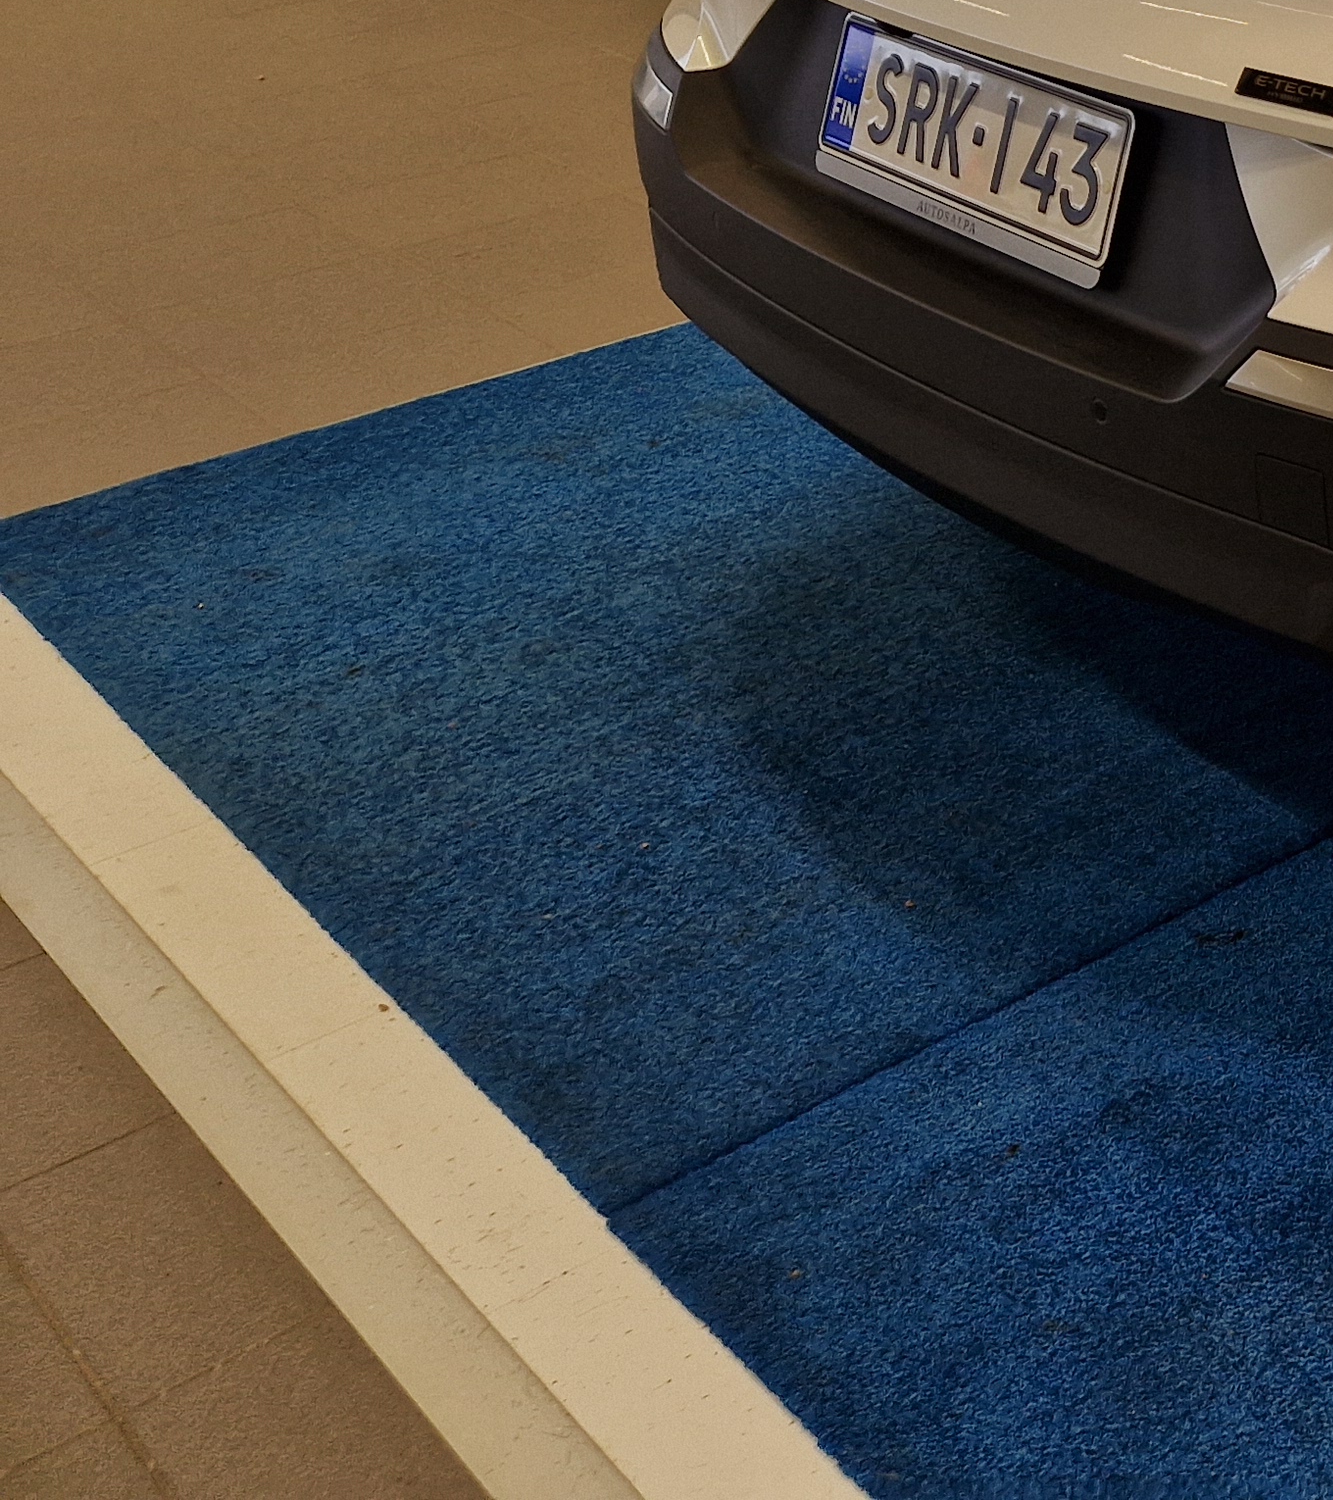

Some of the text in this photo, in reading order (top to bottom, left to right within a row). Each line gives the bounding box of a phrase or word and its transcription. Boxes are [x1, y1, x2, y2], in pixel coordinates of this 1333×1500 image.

[1253, 74, 1328, 100] E-TECH
[829, 96, 857, 130] FIN
[916, 200, 977, 236] AUTOSALPA
